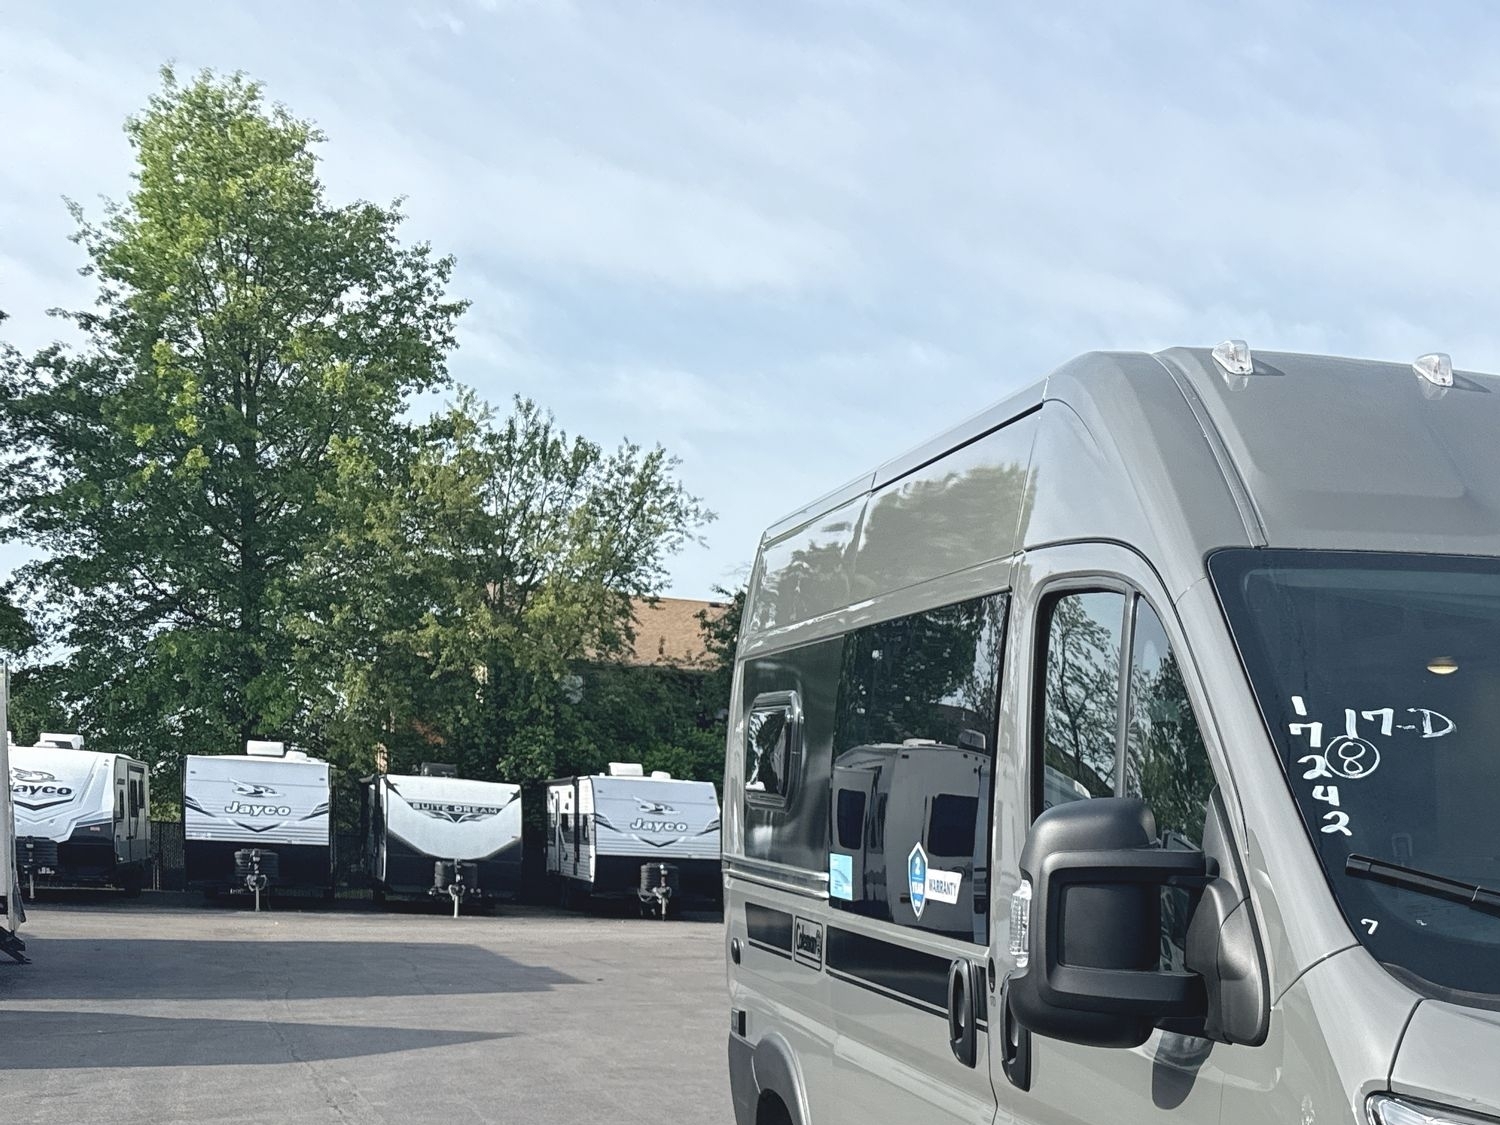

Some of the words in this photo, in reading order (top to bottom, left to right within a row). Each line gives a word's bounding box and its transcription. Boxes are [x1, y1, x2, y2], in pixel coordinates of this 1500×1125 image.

[1344, 707, 1456, 738] 17-D
[1338, 741, 1366, 776] 8
[225, 801, 291, 817] Jayco
[412, 802, 450, 812] SUITE
[453, 804, 498, 814] DREAM
[630, 817, 688, 832] Jayco
[928, 878, 957, 897] WARRANTY
